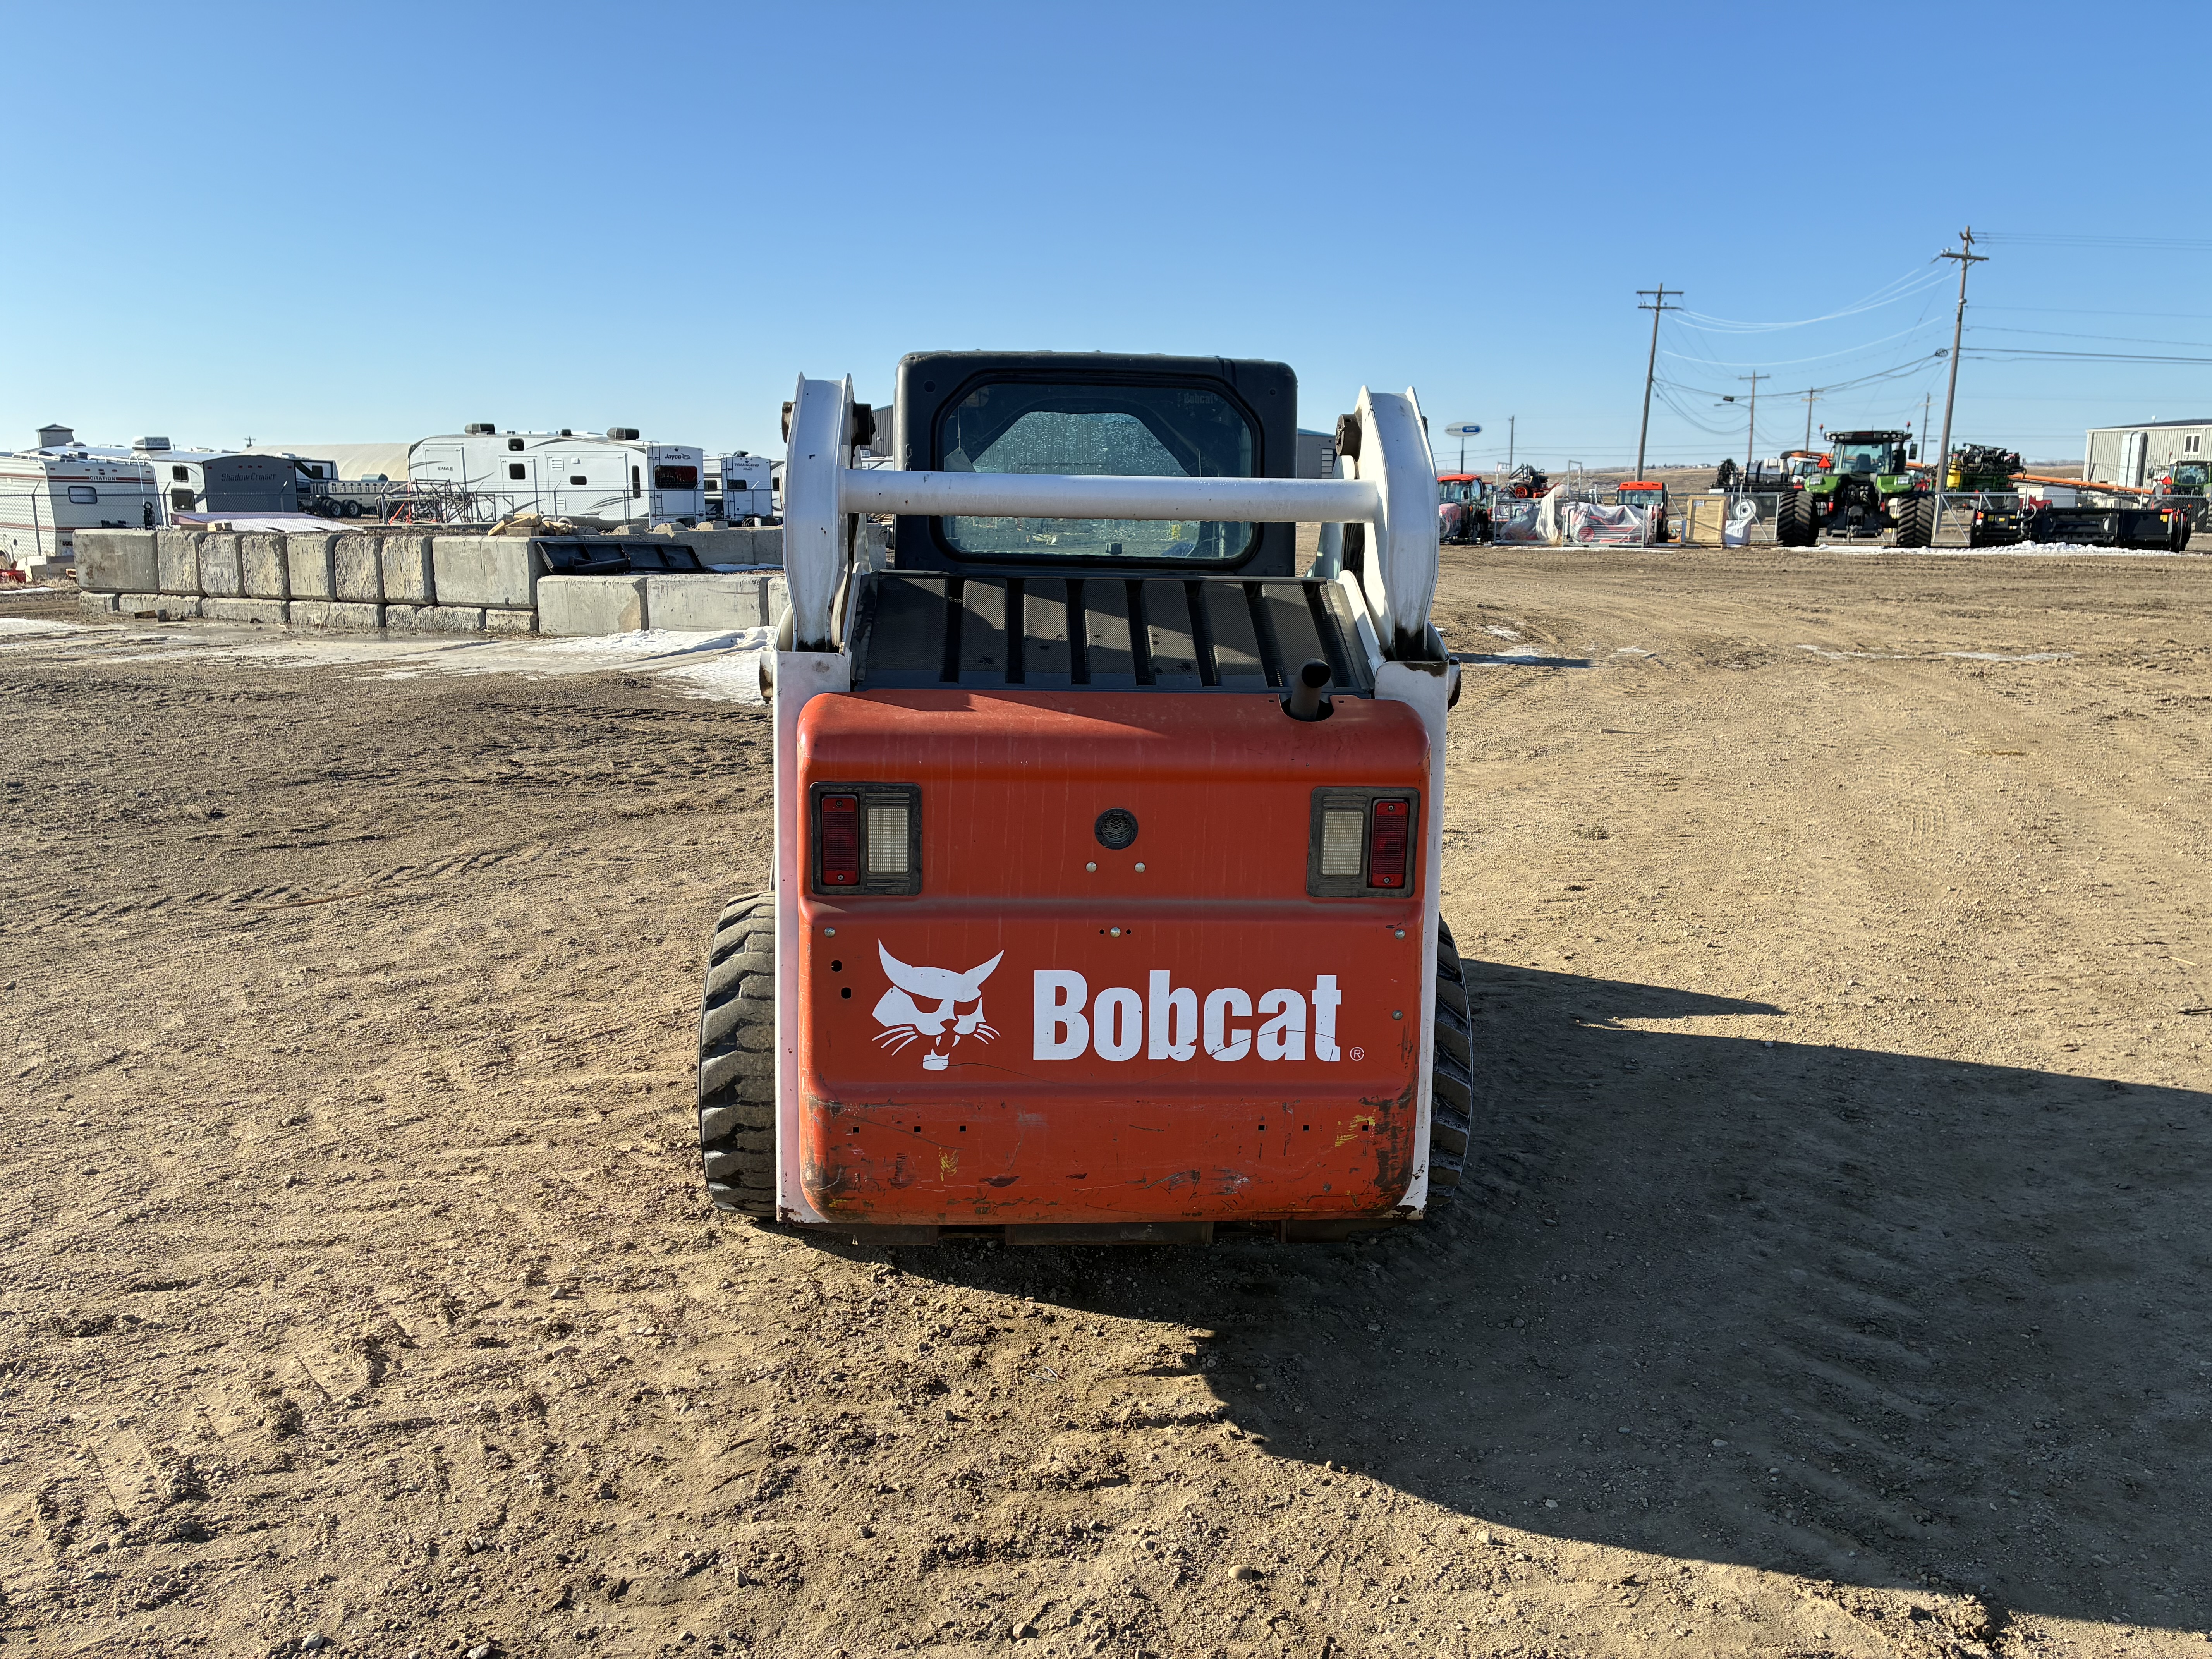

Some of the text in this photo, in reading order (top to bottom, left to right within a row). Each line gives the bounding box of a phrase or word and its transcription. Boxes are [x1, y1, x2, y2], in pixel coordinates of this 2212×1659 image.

[1184, 393, 1214, 404] Bobcat
[221, 472, 276, 481] Shadow Cruiser
[1033, 970, 1342, 1062] Bobcat
